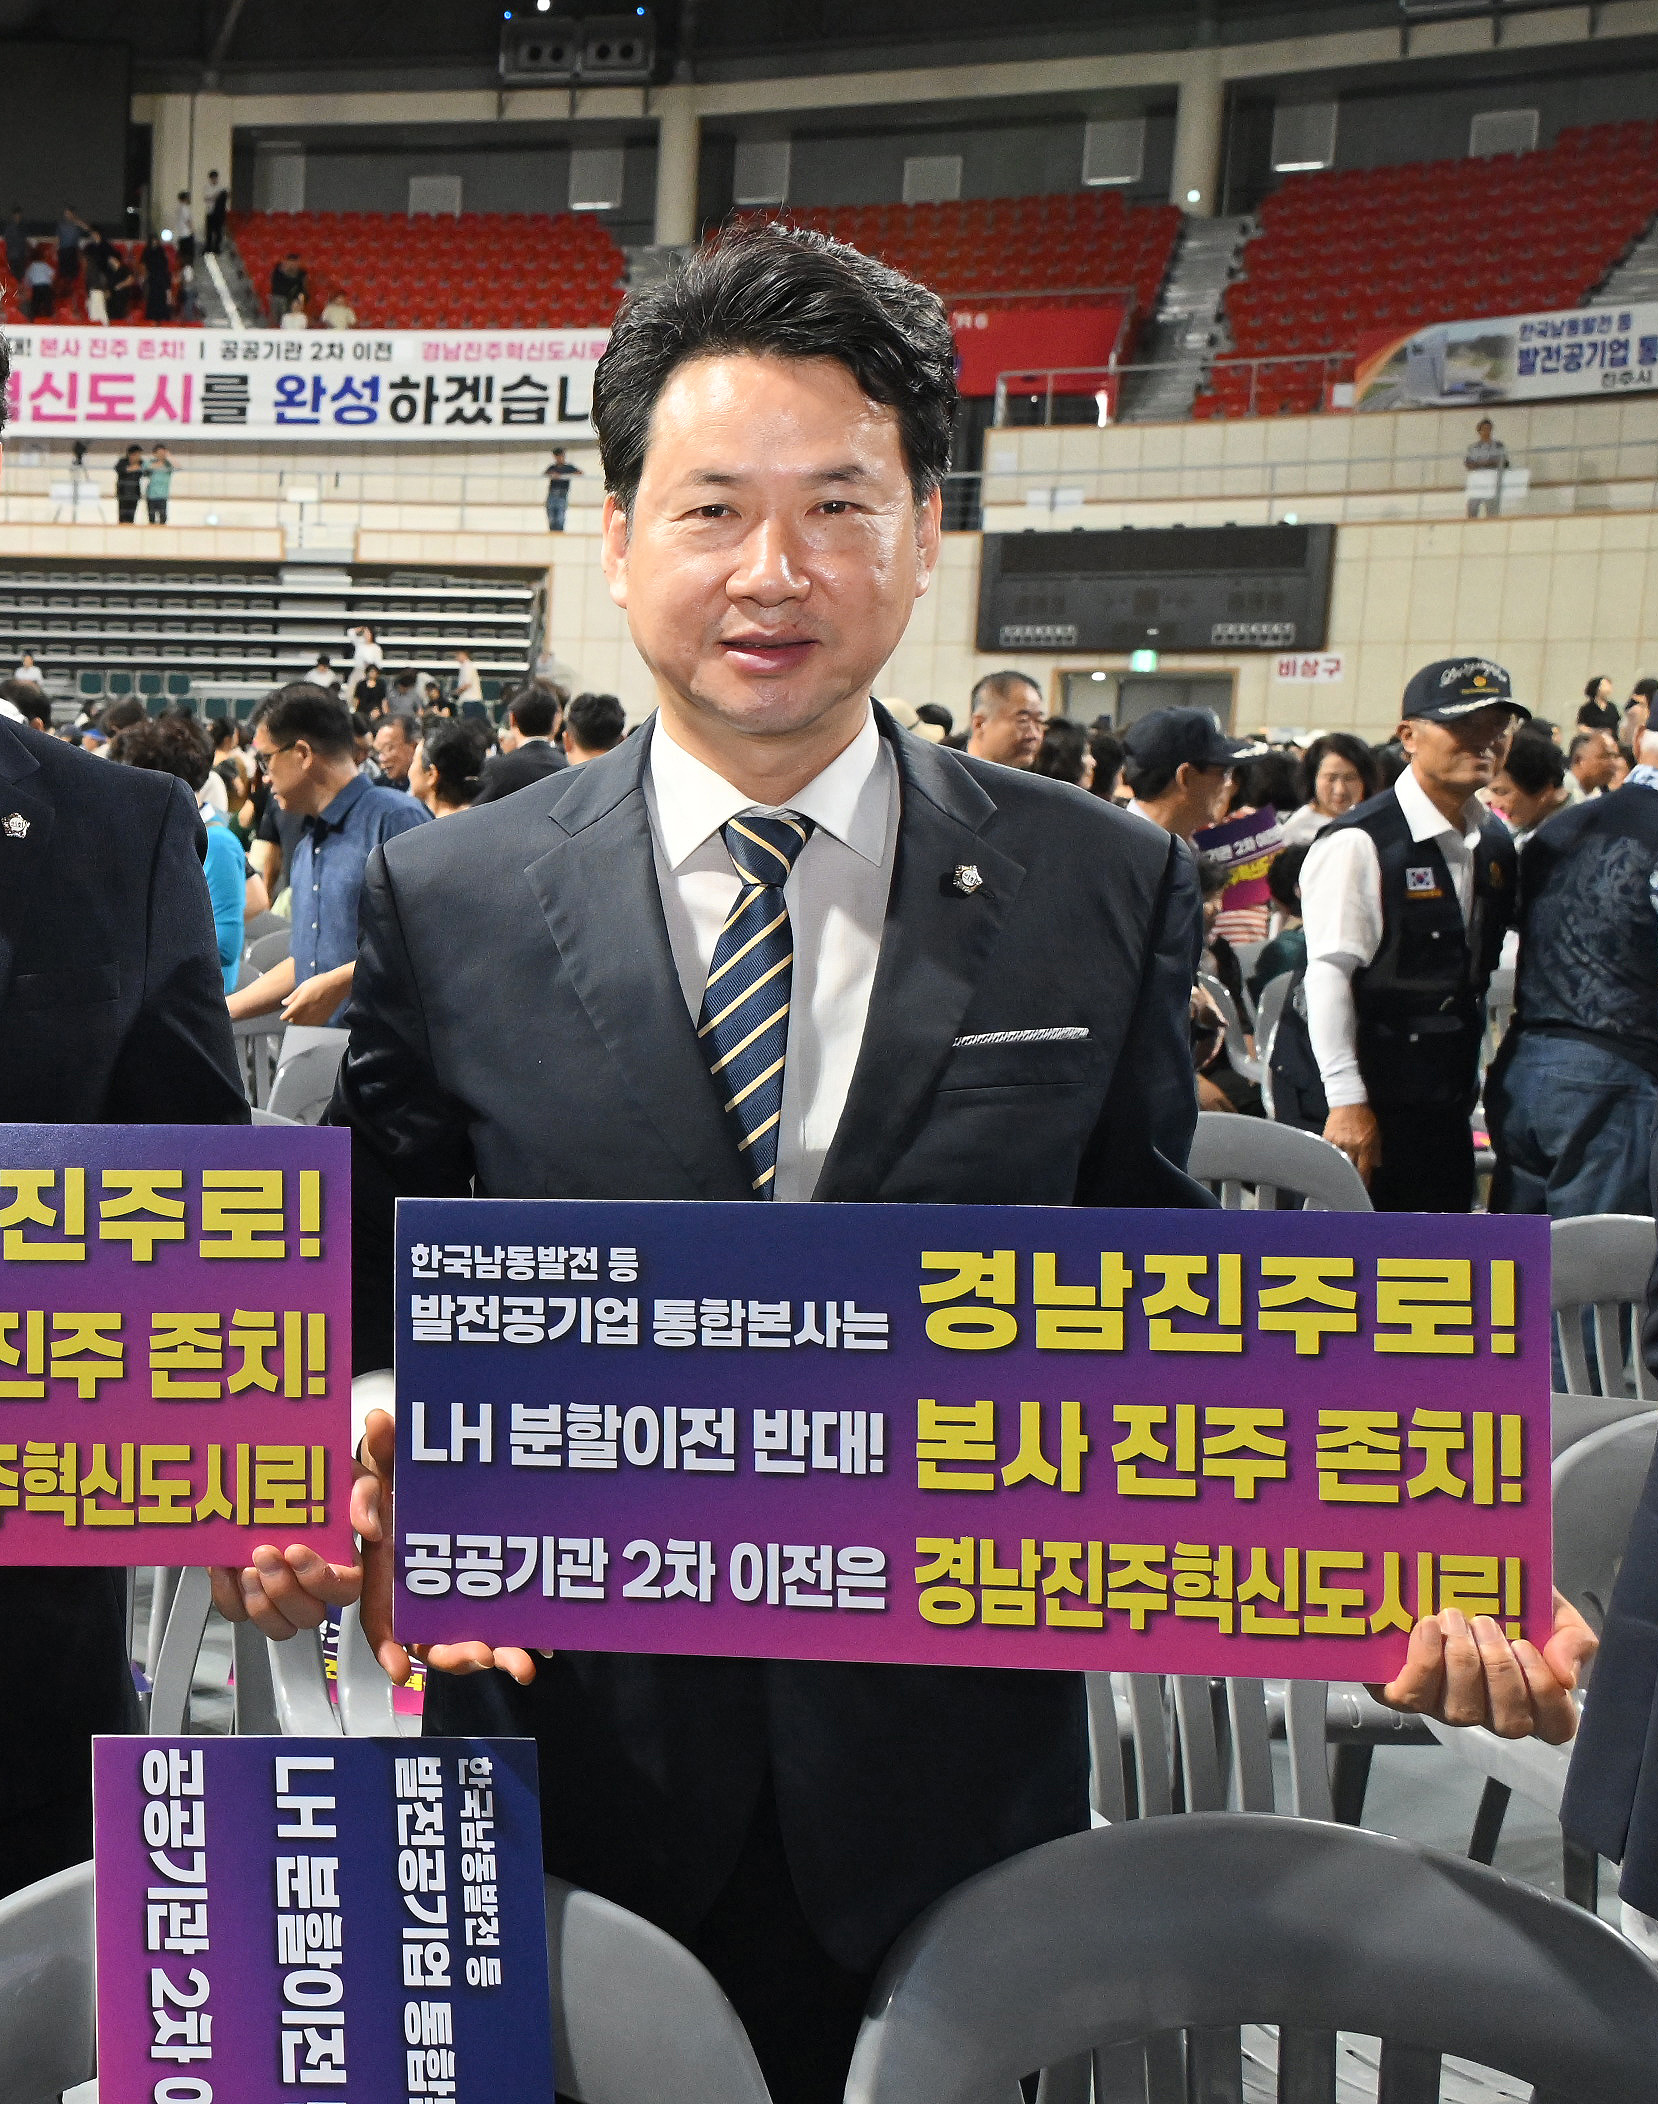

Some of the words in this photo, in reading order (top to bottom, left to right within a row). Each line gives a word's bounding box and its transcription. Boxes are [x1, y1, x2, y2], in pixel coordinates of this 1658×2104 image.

[40, 337, 81, 358] 본사
[89, 338, 129, 359] 진주
[310, 342, 344, 361] 2차
[353, 342, 393, 362] 이전
[1518, 339, 1630, 375] 발전공기업
[1278, 656, 1342, 678] 비상구
[0, 1167, 320, 1262] 진주로!
[411, 1243, 599, 1281] 한국남동발전
[608, 1246, 639, 1282] 등
[411, 1294, 638, 1345] 발전공기업
[652, 1298, 889, 1350] 통합본사는
[918, 1250, 1516, 1355] 경남진주로!
[0, 1310, 124, 1398] 진주
[149, 1308, 326, 1398] 존치!
[411, 1402, 493, 1463] LH
[510, 1403, 736, 1472] 분할이전
[753, 1408, 885, 1474] 반대!
[915, 1399, 1088, 1492] 본사
[1111, 1403, 1287, 1500] 진주
[1316, 1406, 1522, 1505] 존치!
[404, 1532, 609, 1599] 공공기관
[622, 1538, 716, 1602] 2차
[729, 1542, 887, 1610] 이전은
[914, 1536, 1522, 1640] 경남진주혁신도시로!
[275, 1756, 337, 1838] LH
[142, 1748, 210, 1955] 공공기관
[395, 1756, 452, 1987] 발전공기업
[458, 1756, 500, 1946] 한국남동발전
[150, 1967, 213, 2063] 2차
[276, 1855, 348, 2084] 분할이전
[465, 1955, 502, 1987] 등
[404, 2000, 456, 2104] 통합
